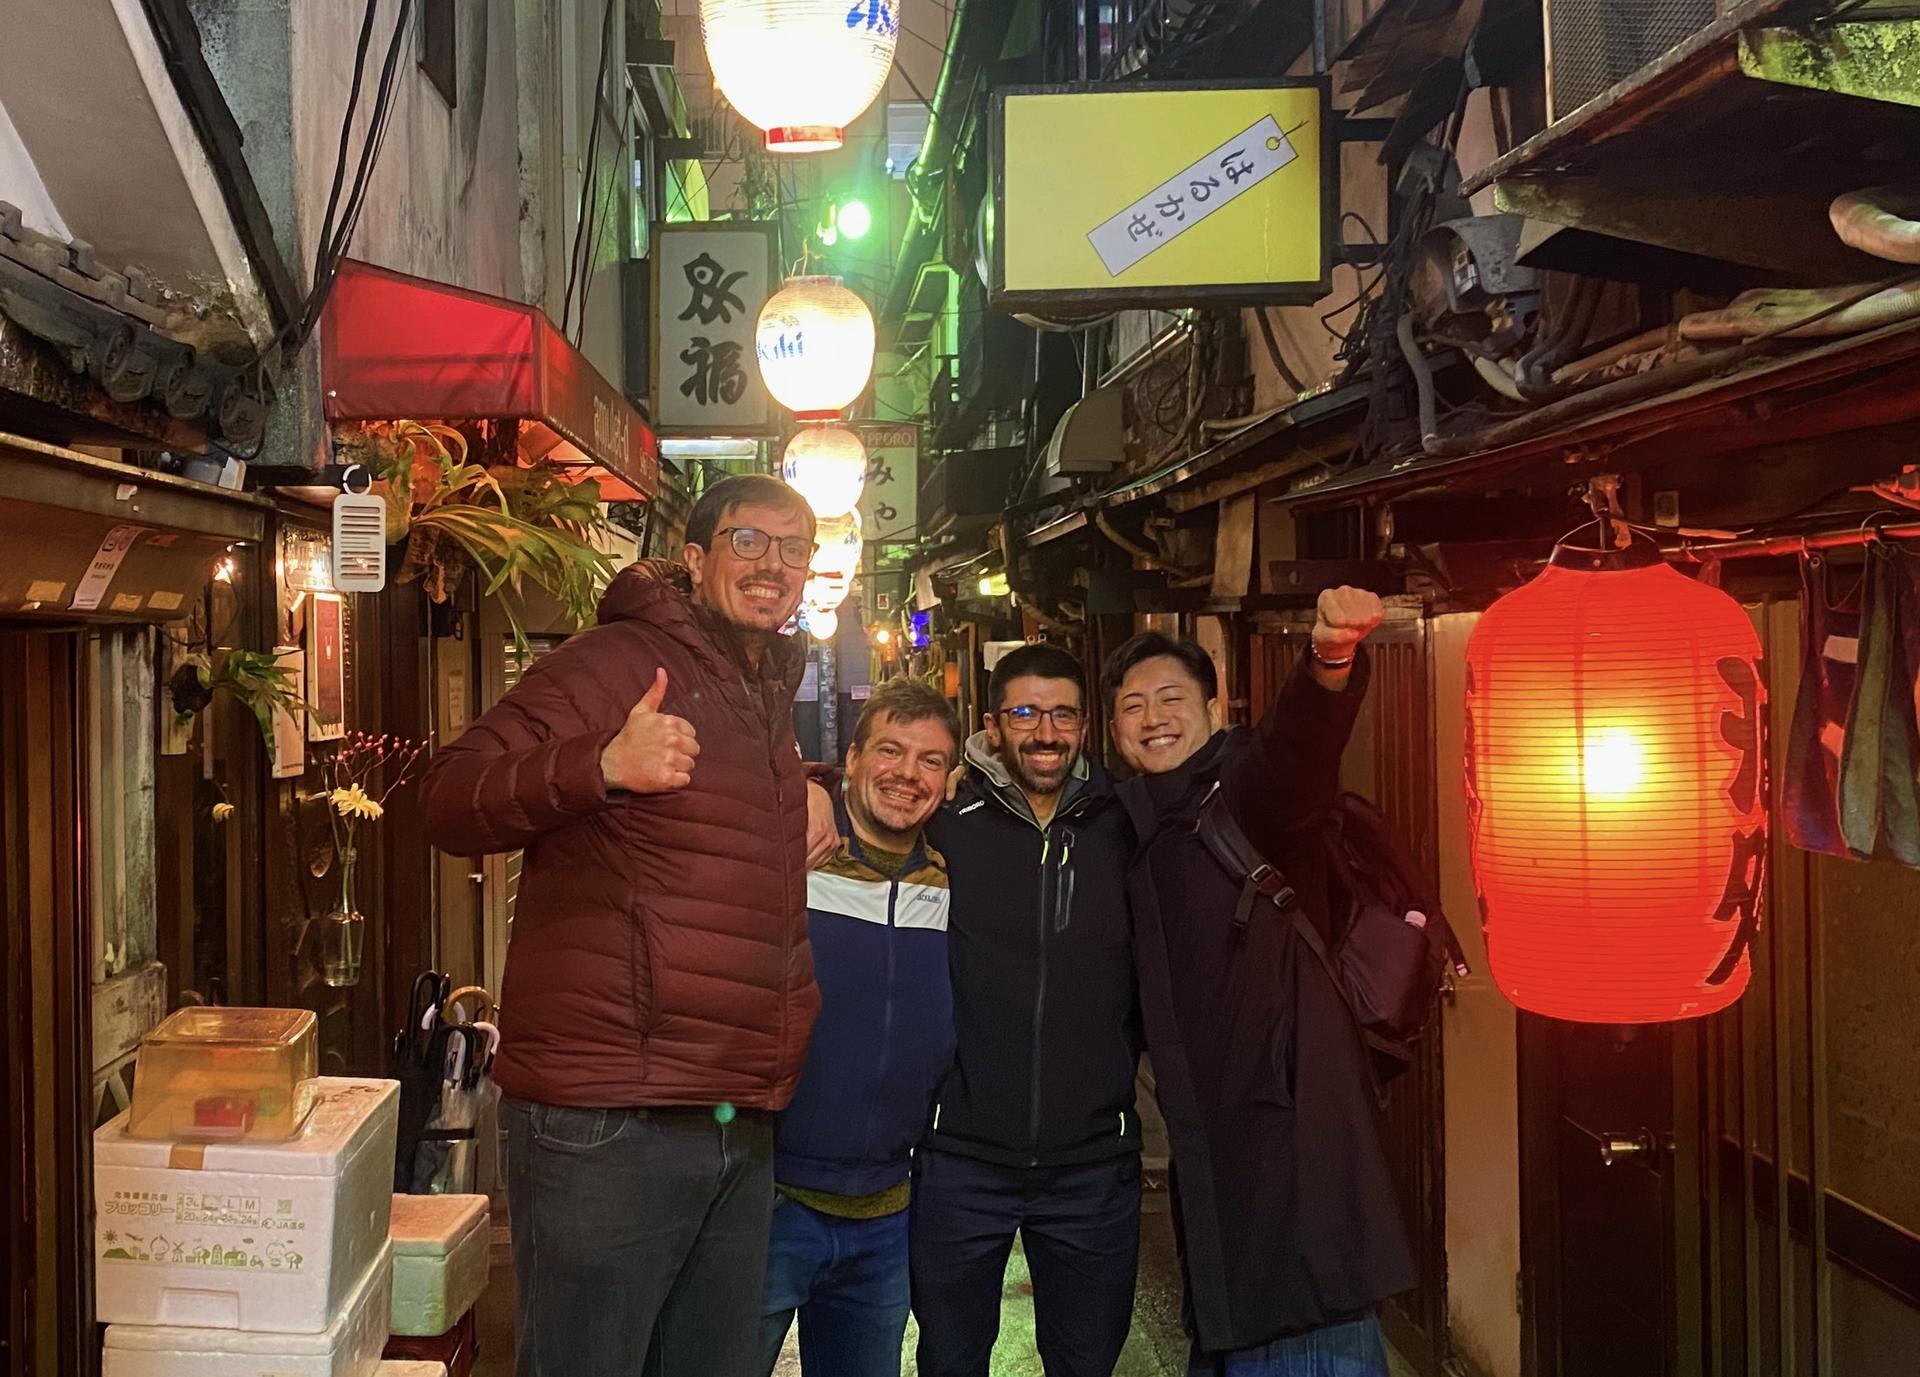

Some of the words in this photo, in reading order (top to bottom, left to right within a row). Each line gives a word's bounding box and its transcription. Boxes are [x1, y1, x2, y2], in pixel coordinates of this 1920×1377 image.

[1127, 148, 1254, 242] はるかぜ
[245, 1200, 255, 1210] M
